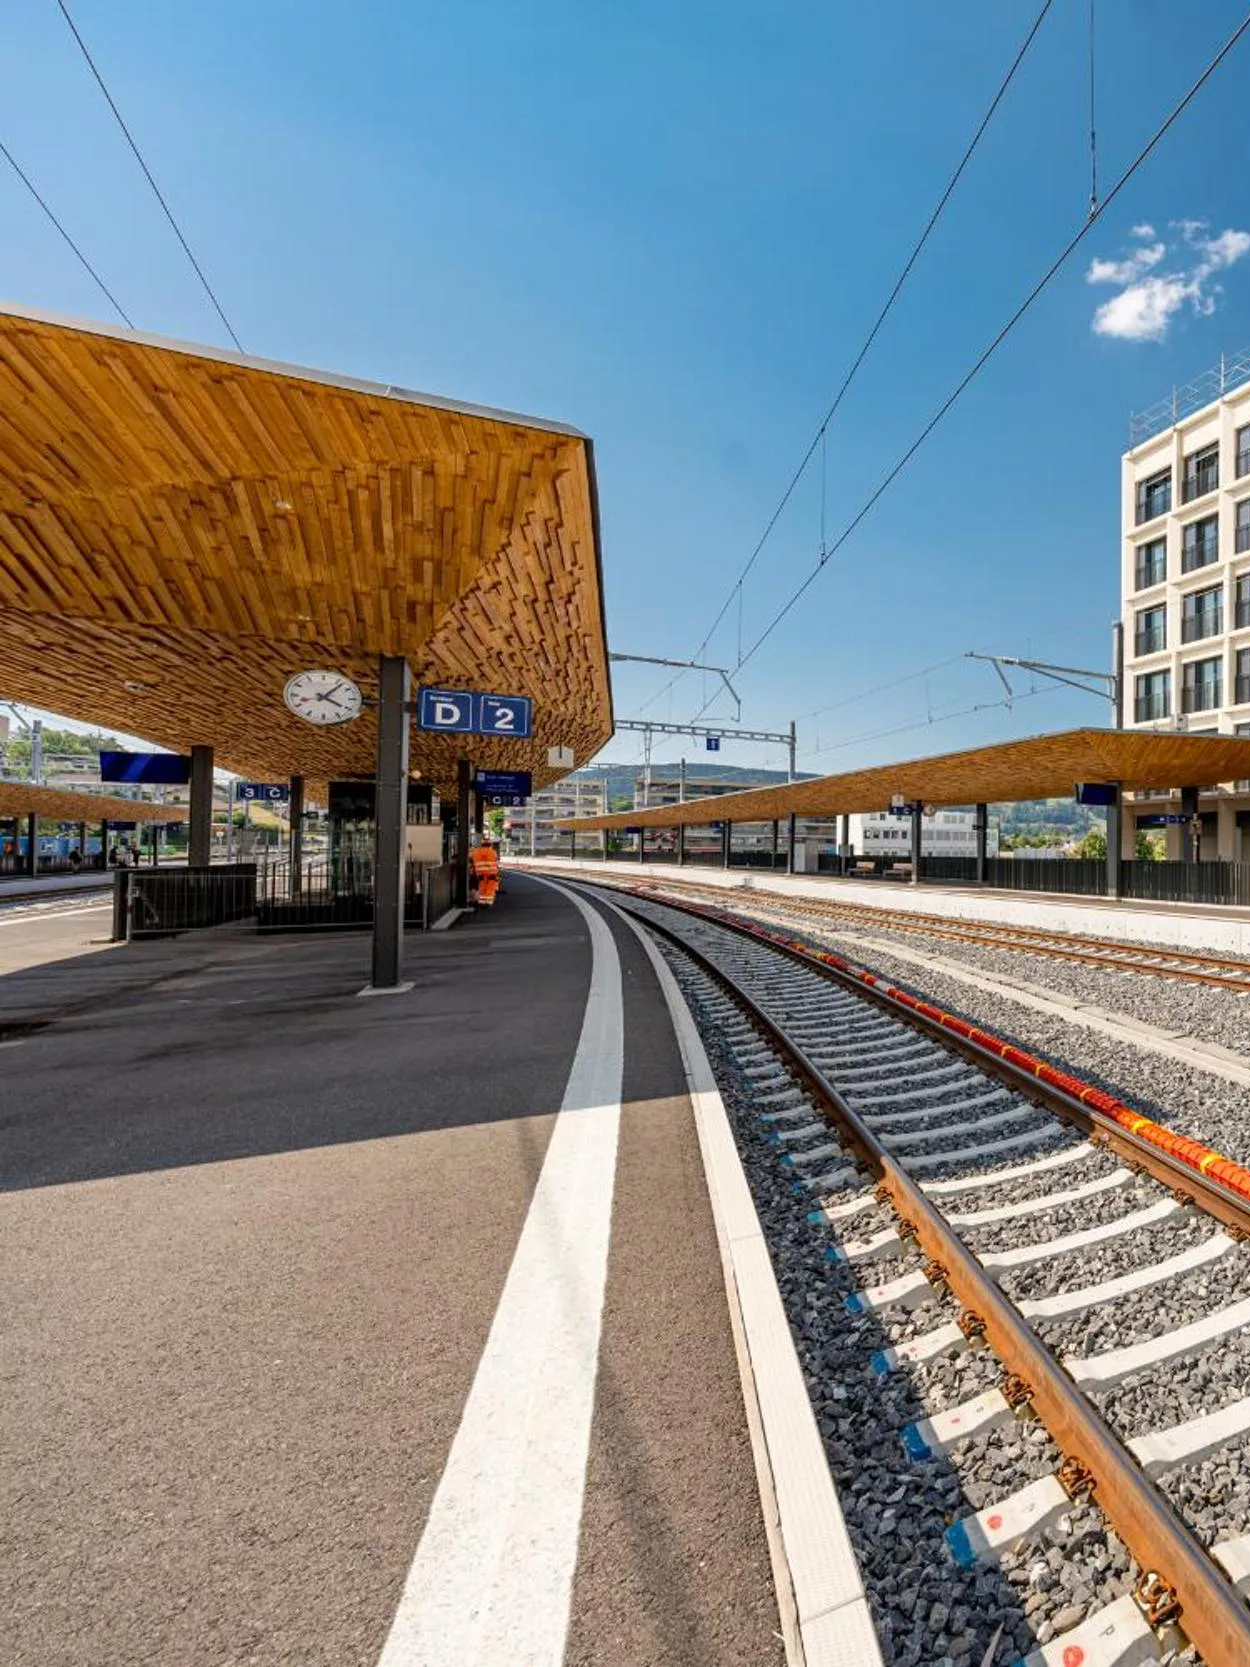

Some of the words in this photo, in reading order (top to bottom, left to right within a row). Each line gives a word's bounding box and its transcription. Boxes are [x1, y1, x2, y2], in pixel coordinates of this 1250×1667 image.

[435, 702, 461, 725] D
[494, 707, 515, 730] 2
[244, 787, 255, 798] 3
[269, 787, 281, 798] C
